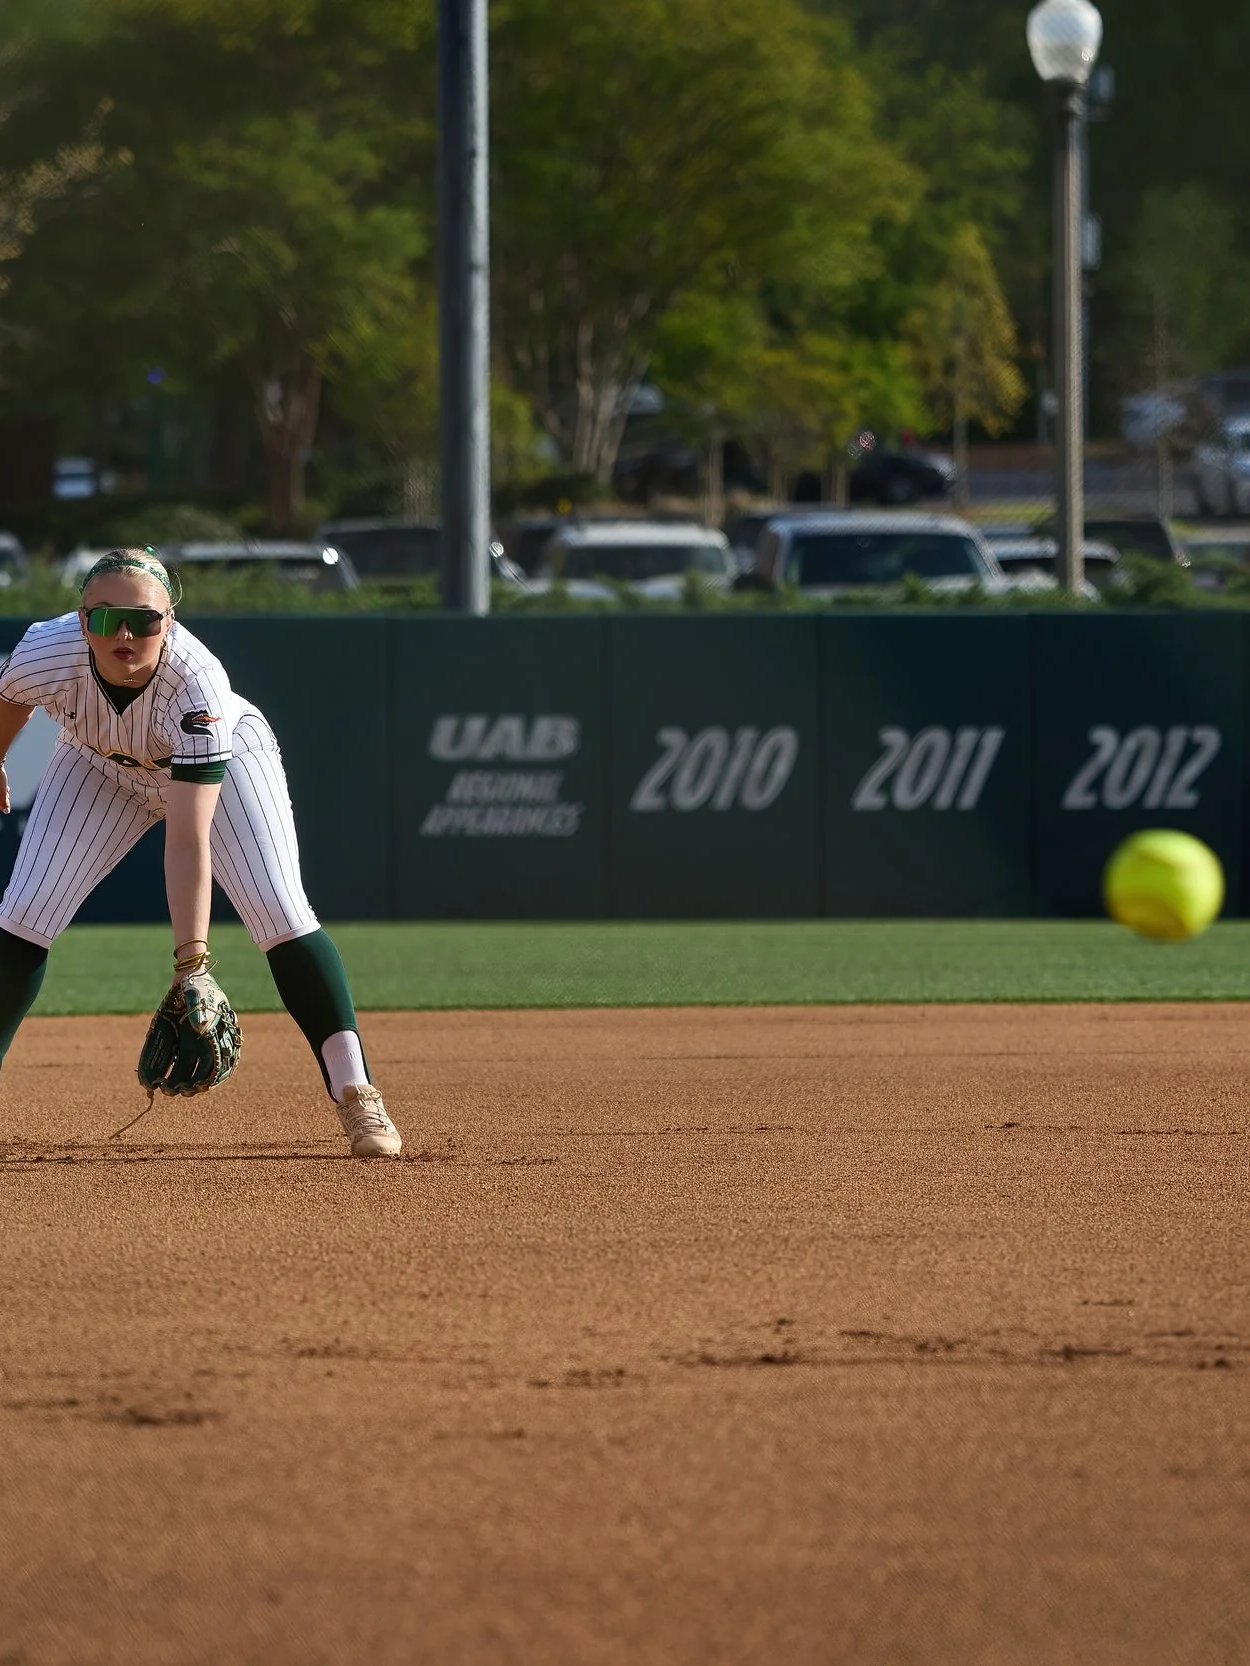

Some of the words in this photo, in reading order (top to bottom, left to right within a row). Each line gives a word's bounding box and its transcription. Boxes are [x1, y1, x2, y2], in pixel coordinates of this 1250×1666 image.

[429, 714, 581, 761] UAB
[629, 726, 799, 812] 2010
[852, 725, 1006, 812] 2011
[1061, 725, 1222, 810] 2012
